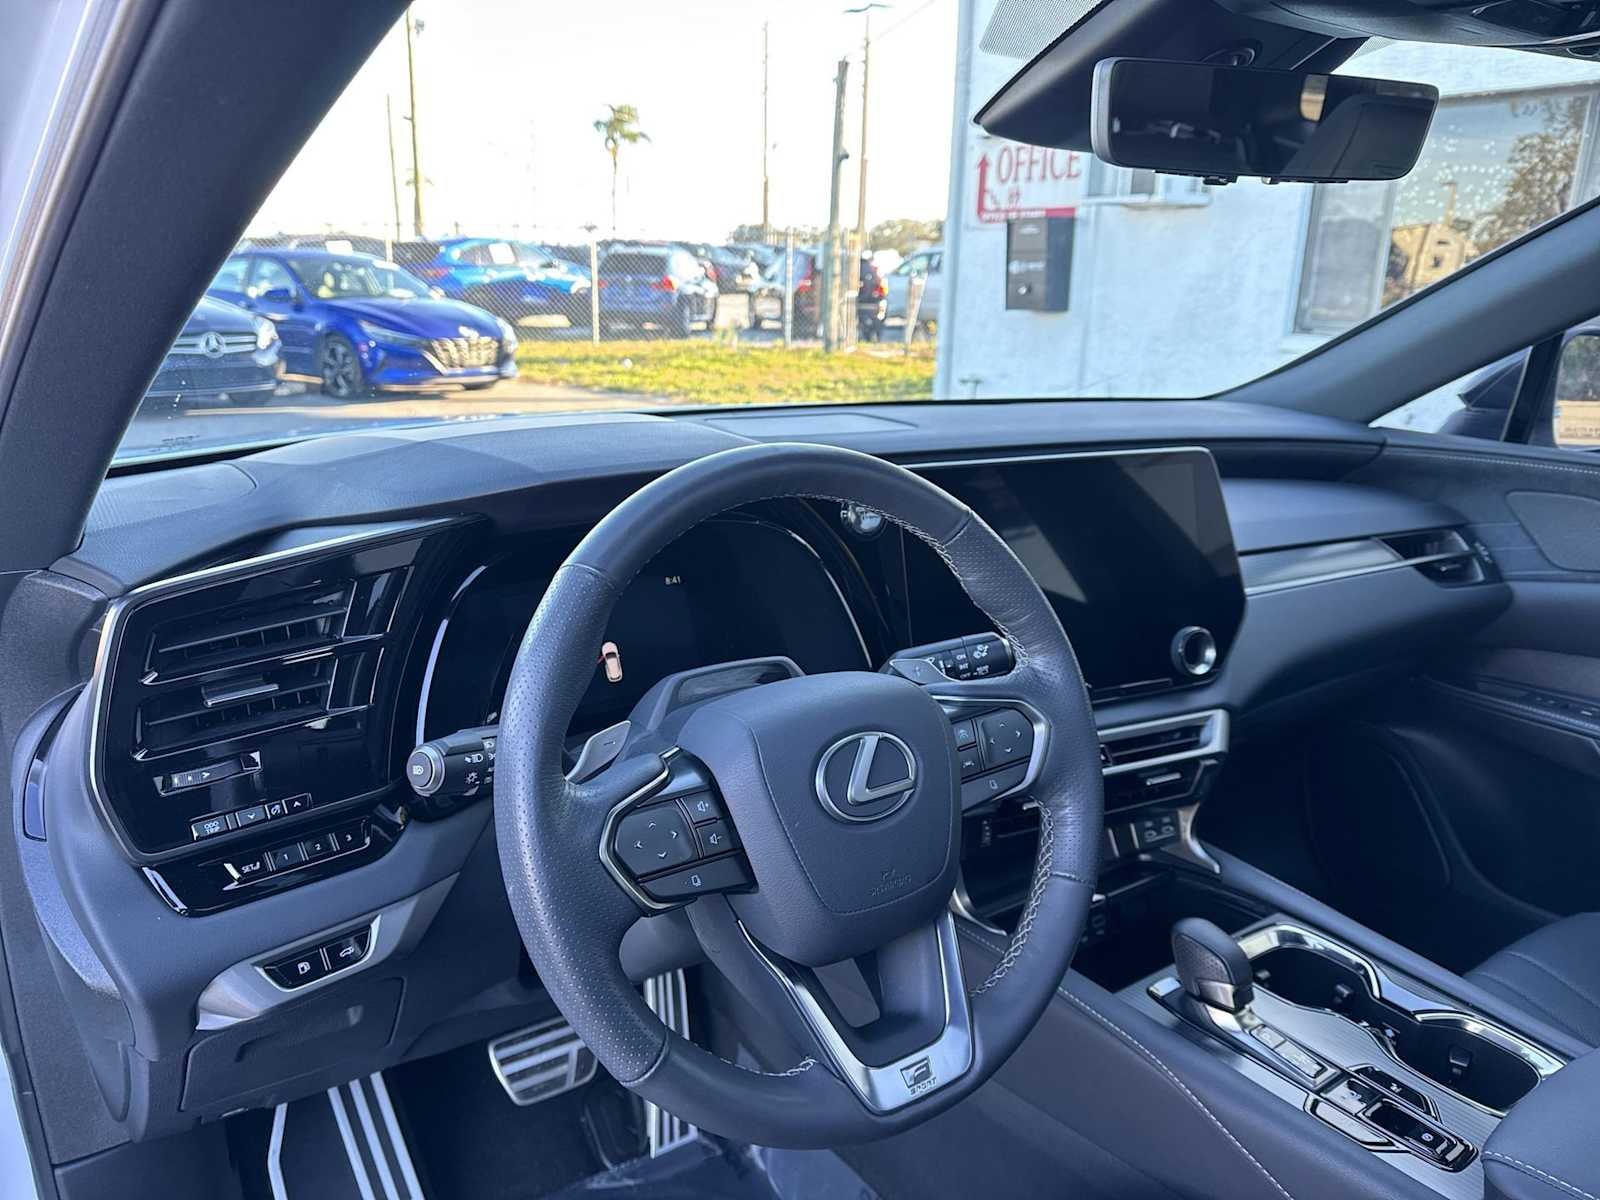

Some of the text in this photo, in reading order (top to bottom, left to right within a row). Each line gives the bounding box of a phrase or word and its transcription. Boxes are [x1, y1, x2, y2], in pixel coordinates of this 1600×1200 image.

[997, 146, 1081, 183] OFFICE
[345, 834, 353, 842] 3
[315, 843, 322, 851] 2
[910, 1077, 937, 1095] SPORT
